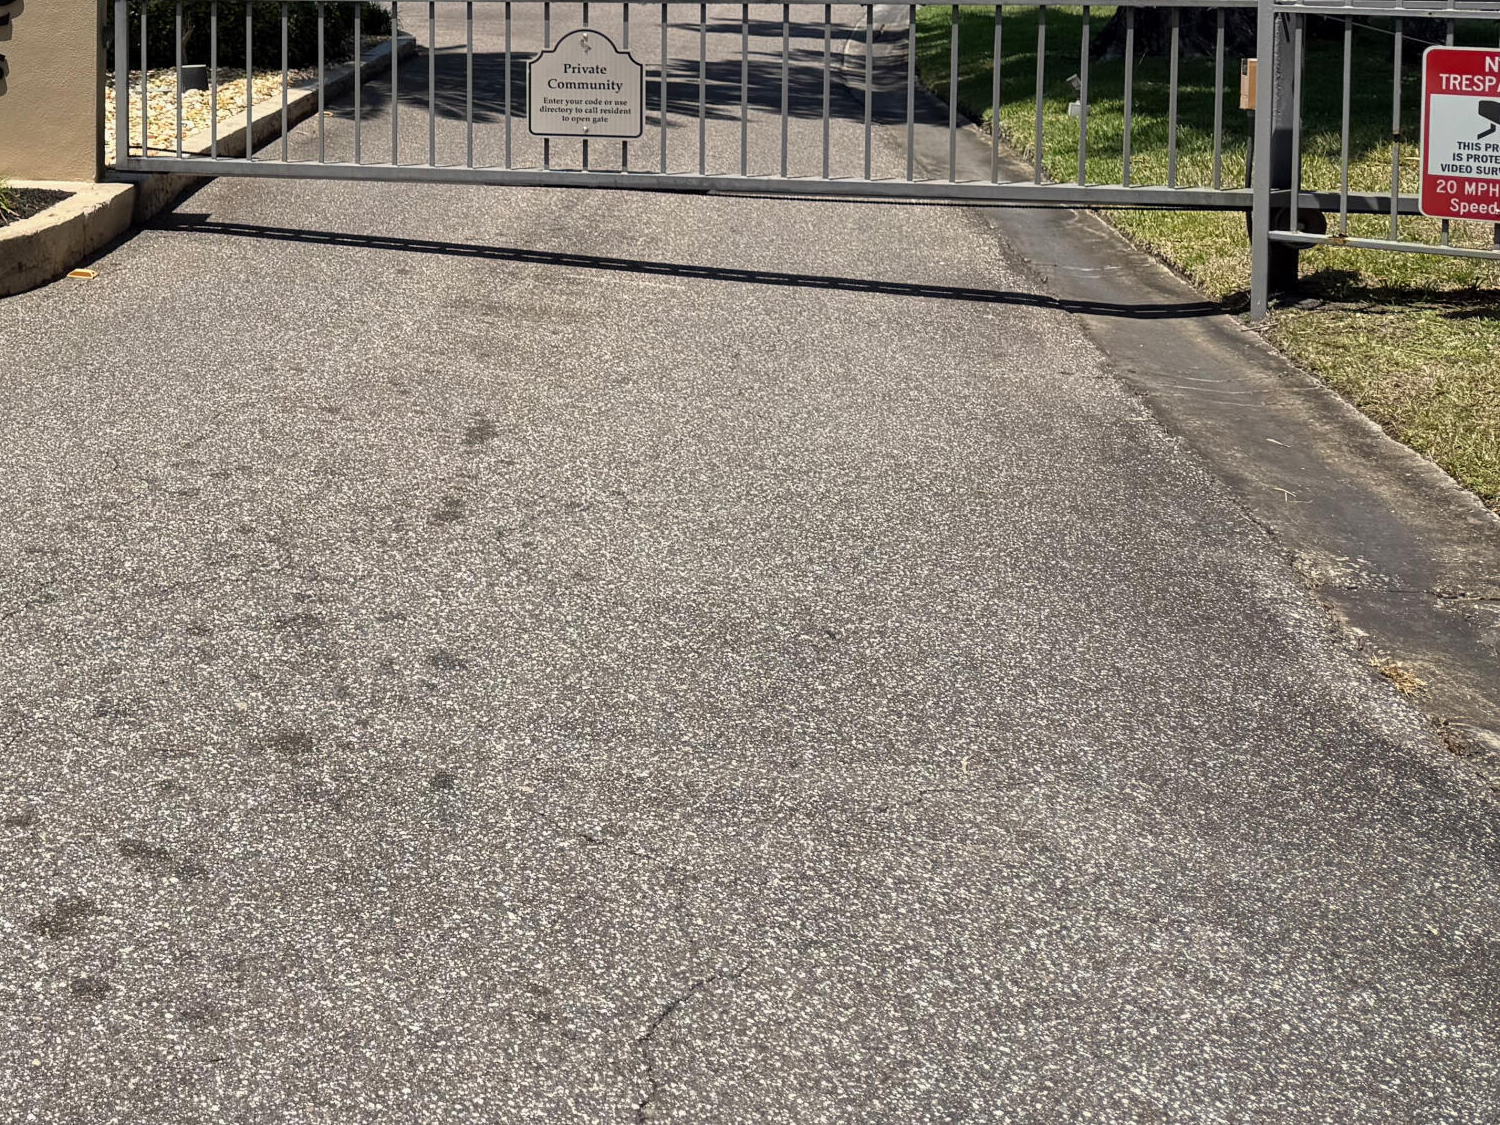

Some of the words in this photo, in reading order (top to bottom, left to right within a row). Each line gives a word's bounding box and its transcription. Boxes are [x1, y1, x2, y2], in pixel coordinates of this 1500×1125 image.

[563, 63, 607, 75] Private
[1485, 56, 1500, 73] N
[547, 78, 623, 93] Community
[1439, 73, 1500, 92] TRESP
[543, 97, 564, 105] Enter
[565, 98, 583, 106] your
[540, 106, 573, 115] directory
[575, 106, 583, 114] to
[600, 107, 631, 115] resident
[592, 116, 609, 124] gate
[1457, 141, 1482, 151] THIS
[1485, 143, 1500, 152] PR
[1452, 153, 1463, 162] IS
[1440, 163, 1473, 174] VIDEO
[1476, 166, 1500, 175] SUR
[1436, 179, 1457, 194] 20
[1464, 181, 1499, 198] MPH
[1449, 198, 1499, 215] Speed
